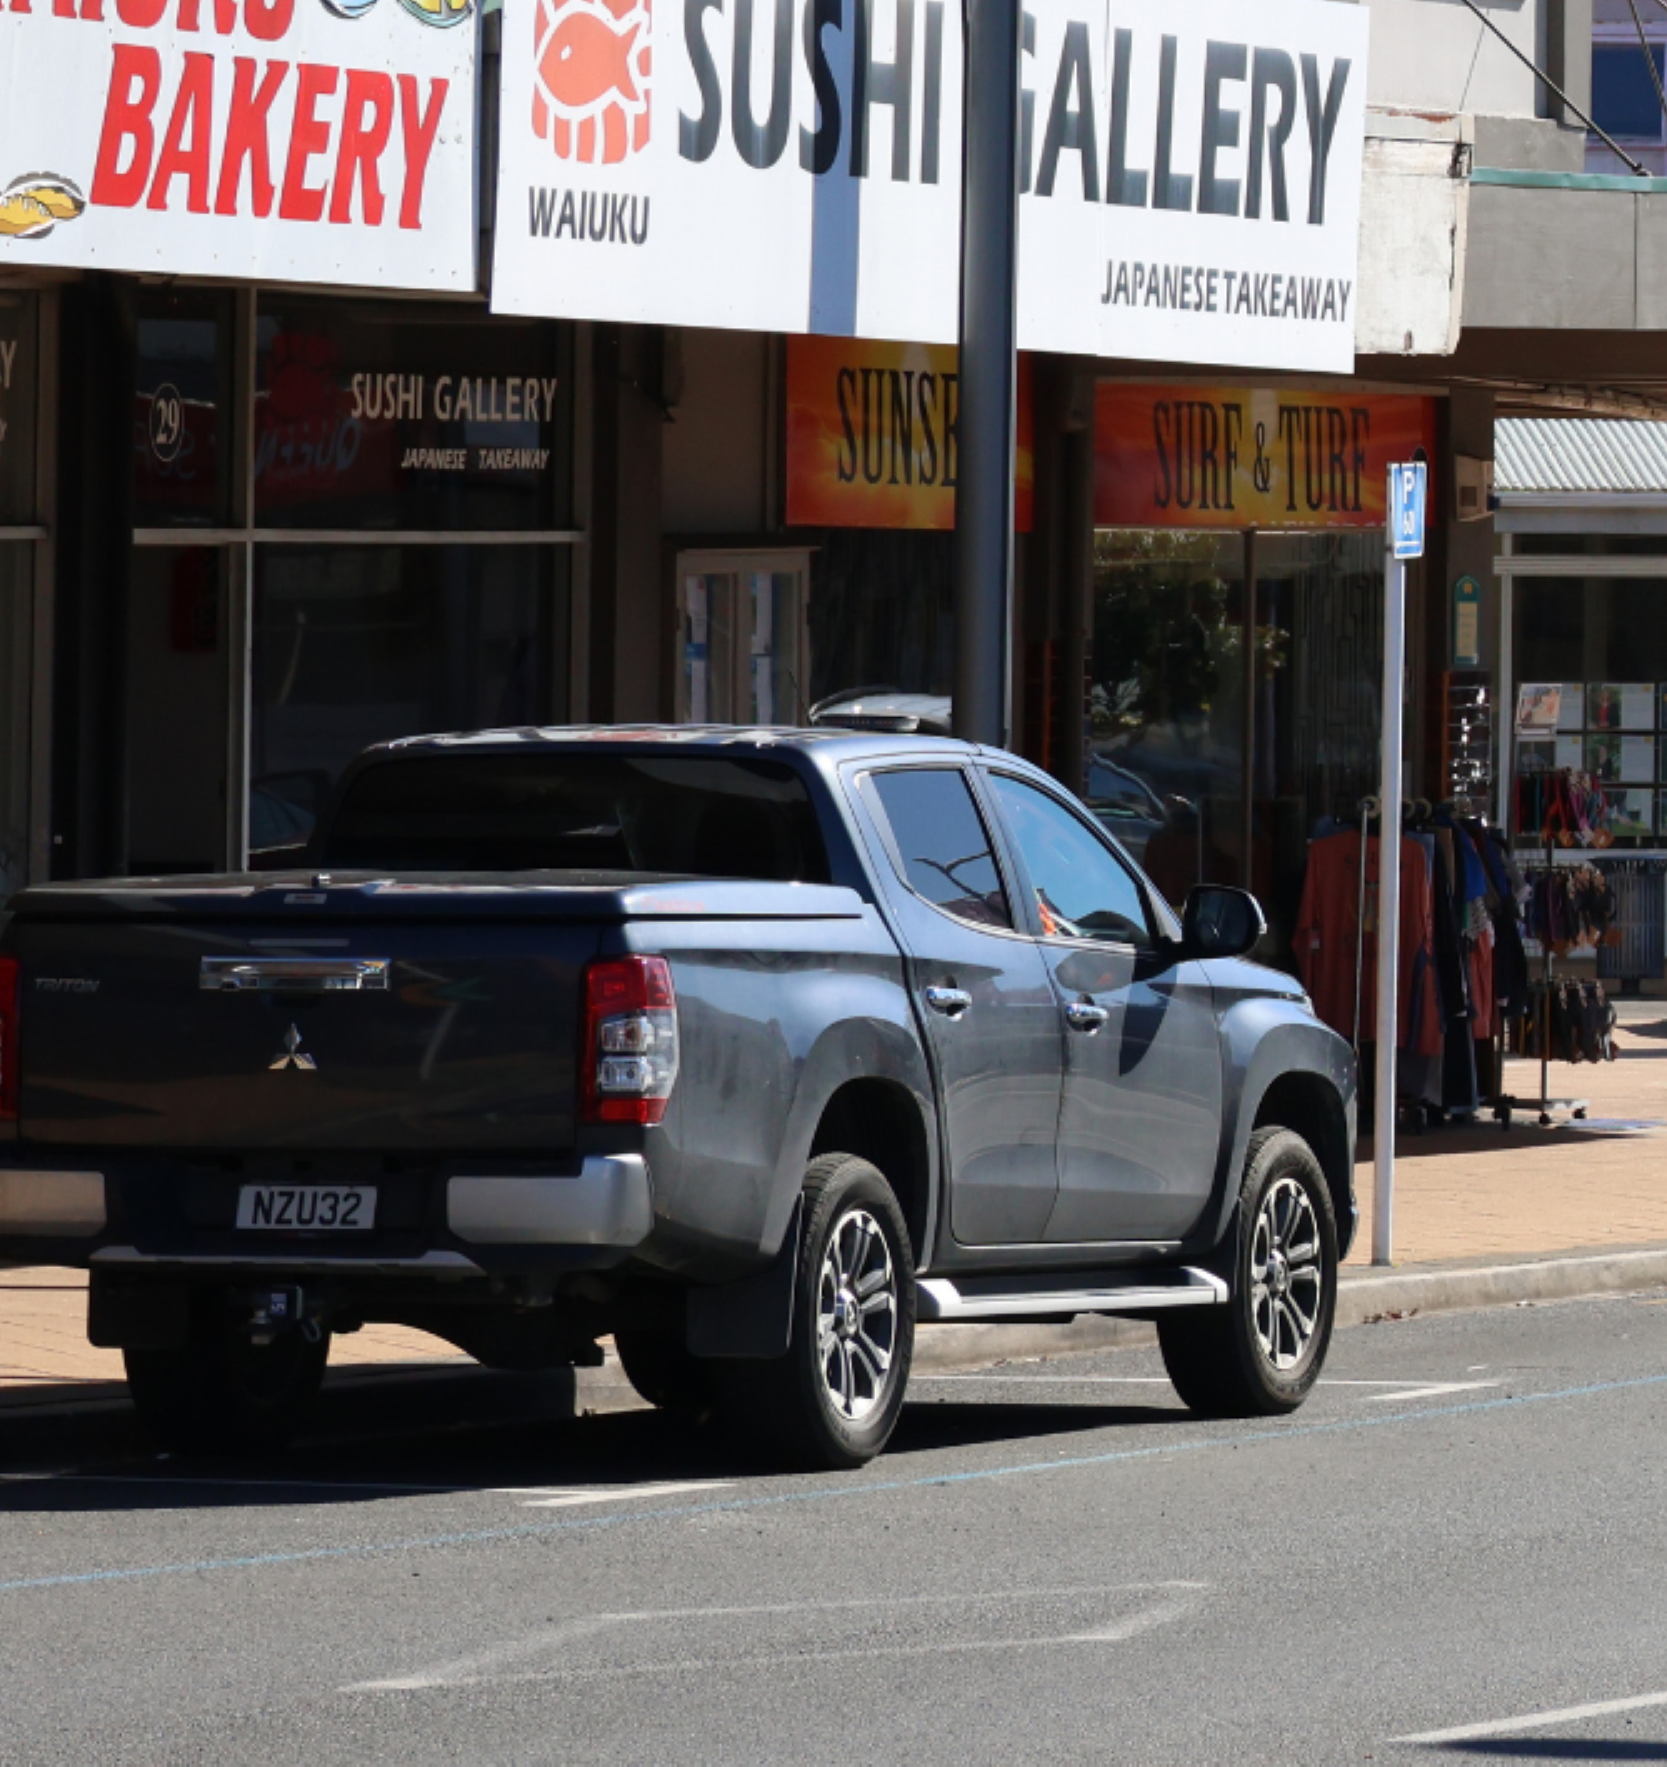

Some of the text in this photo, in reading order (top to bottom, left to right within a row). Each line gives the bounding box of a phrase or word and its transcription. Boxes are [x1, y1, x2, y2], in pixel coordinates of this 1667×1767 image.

[89, 42, 450, 229] BAKERY
[528, 185, 651, 247] WAIUKU
[1101, 258, 1353, 323] JAPANESE TAKEAWAY
[156, 398, 180, 444] 29
[350, 372, 558, 423] SUSHI GALLERY
[837, 366, 959, 488] SUNSE
[400, 447, 551, 470] JAPANESE TAKEAWAY
[1153, 400, 1370, 512] SURF & TURF
[1404, 471, 1415, 504] P
[251, 1190, 362, 1225] NZU32
